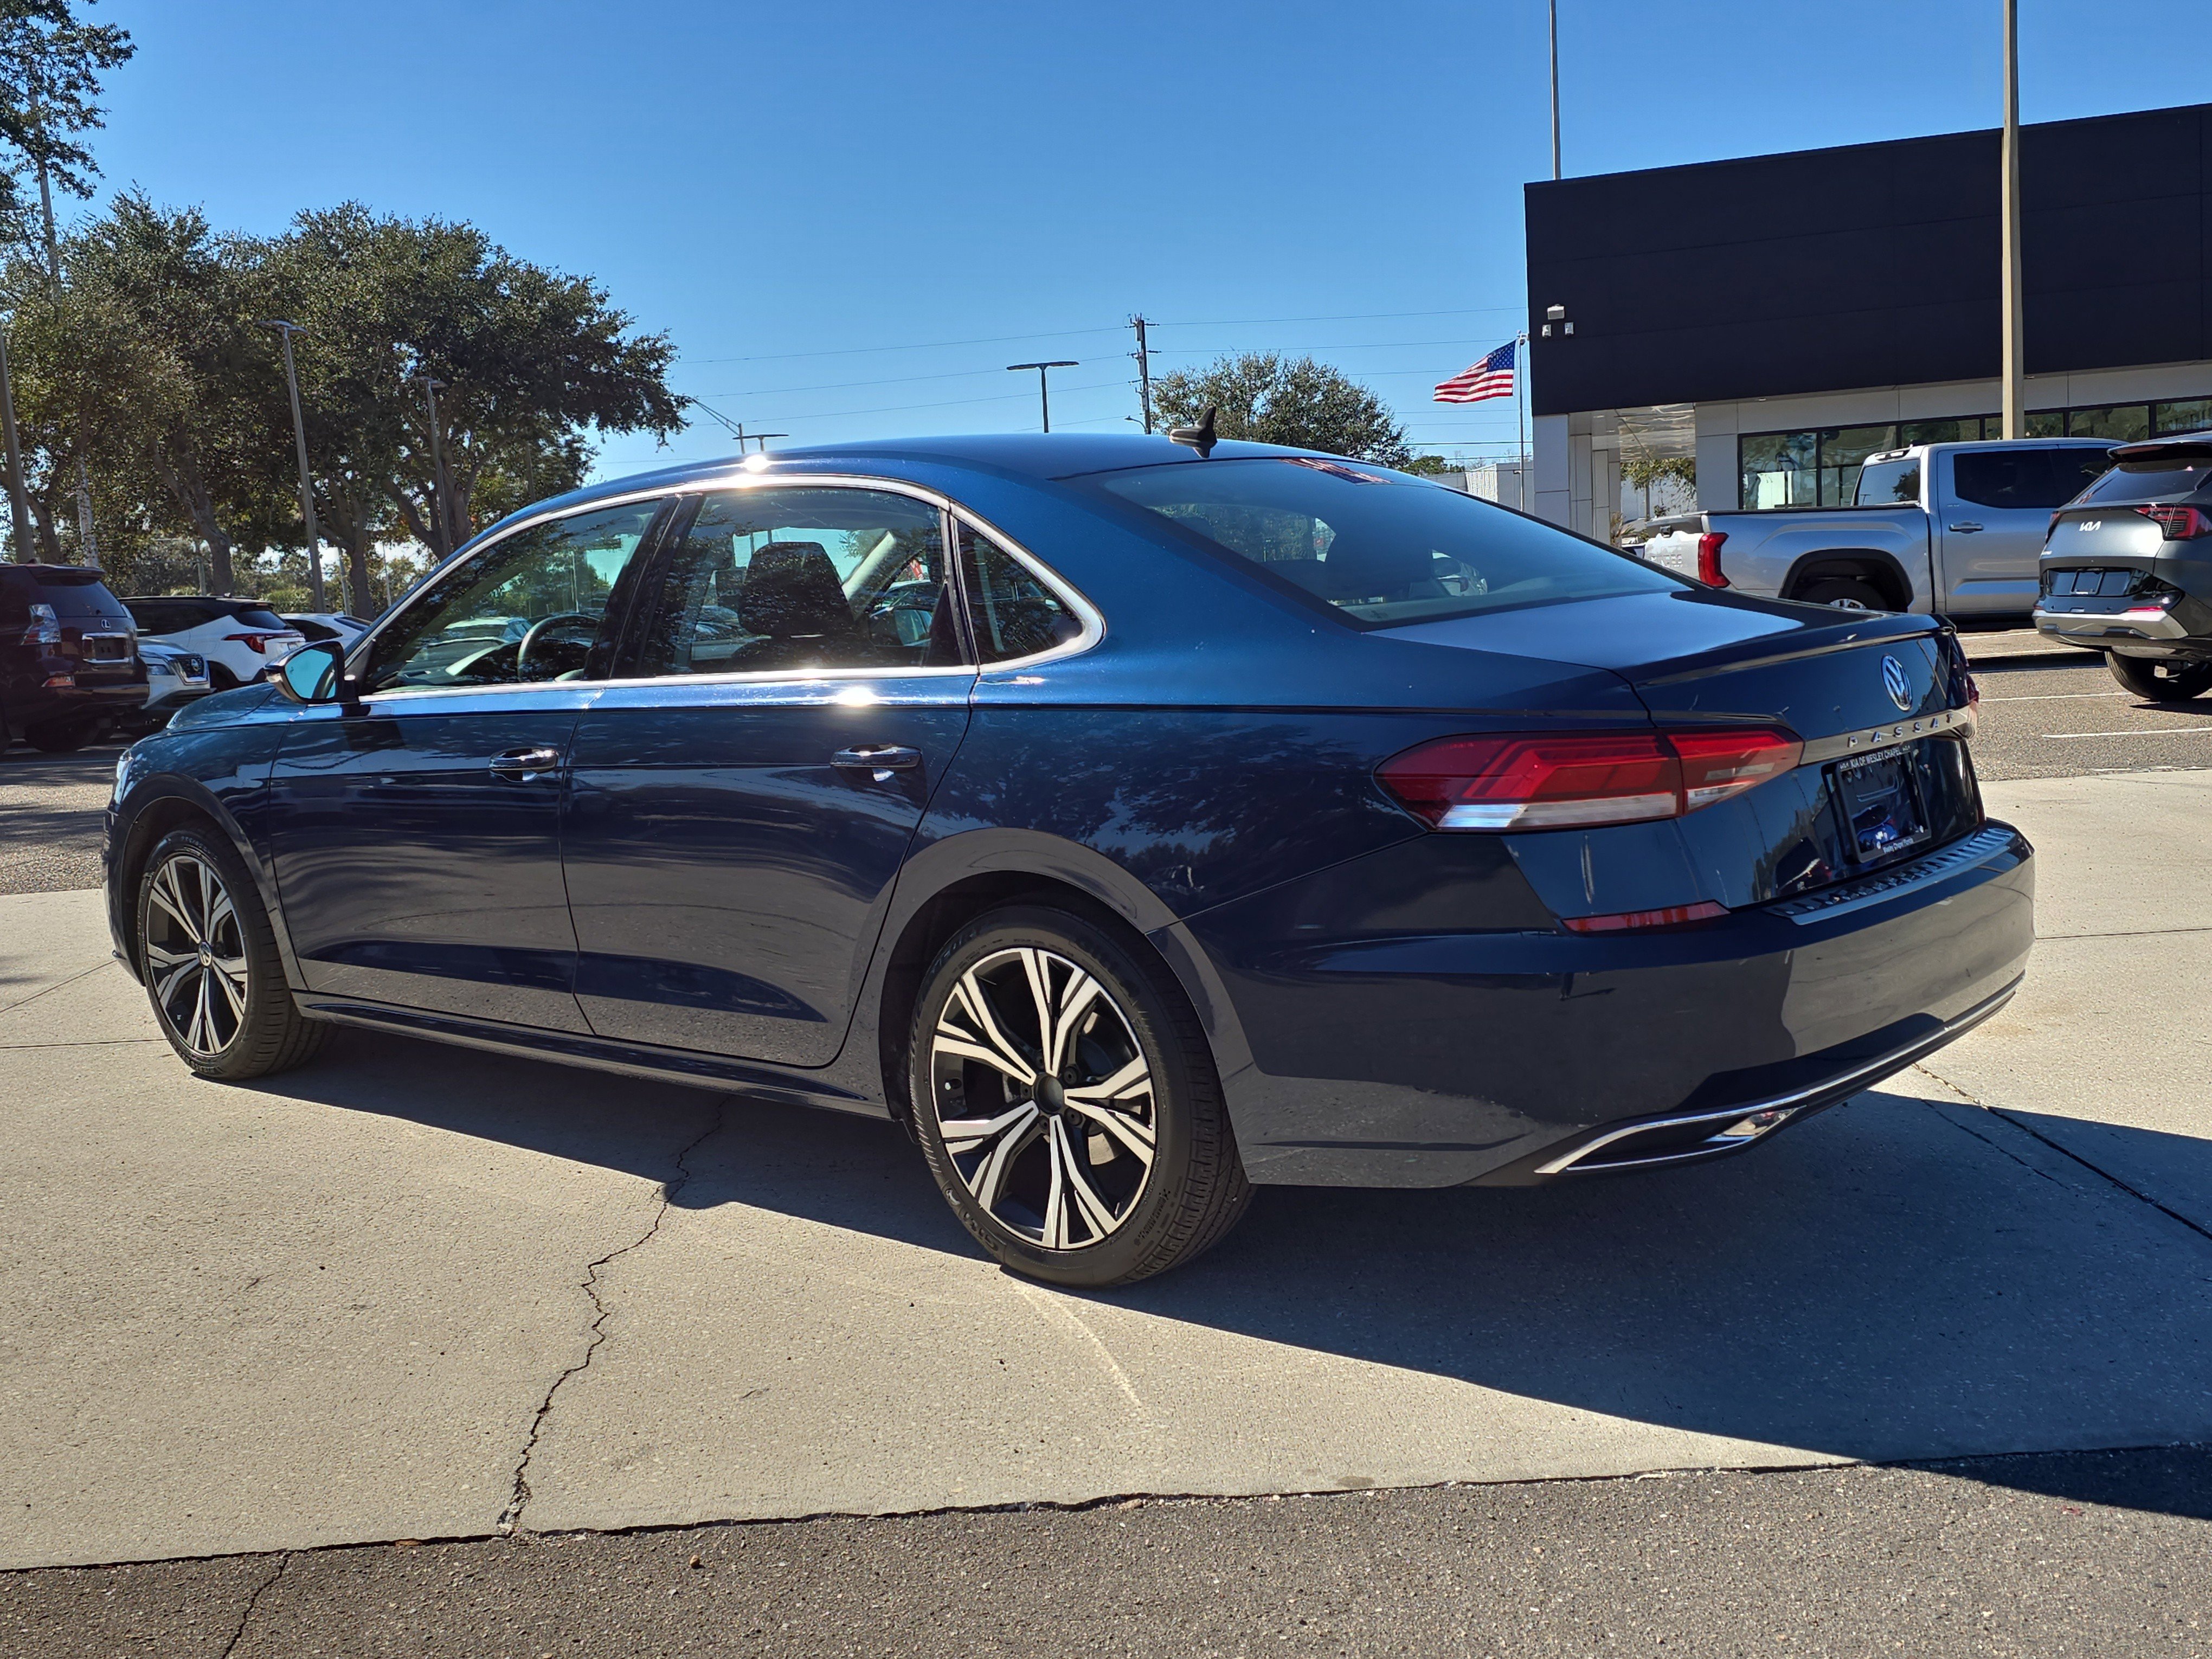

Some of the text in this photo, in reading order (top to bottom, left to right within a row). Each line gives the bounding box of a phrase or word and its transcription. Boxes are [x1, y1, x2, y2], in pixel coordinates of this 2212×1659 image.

[2079, 520, 2101, 531] KIA
[1848, 713, 1953, 748] PASSAT
[1865, 751, 1885, 764] WESLEY
[1884, 746, 1902, 760] CHAPEL
